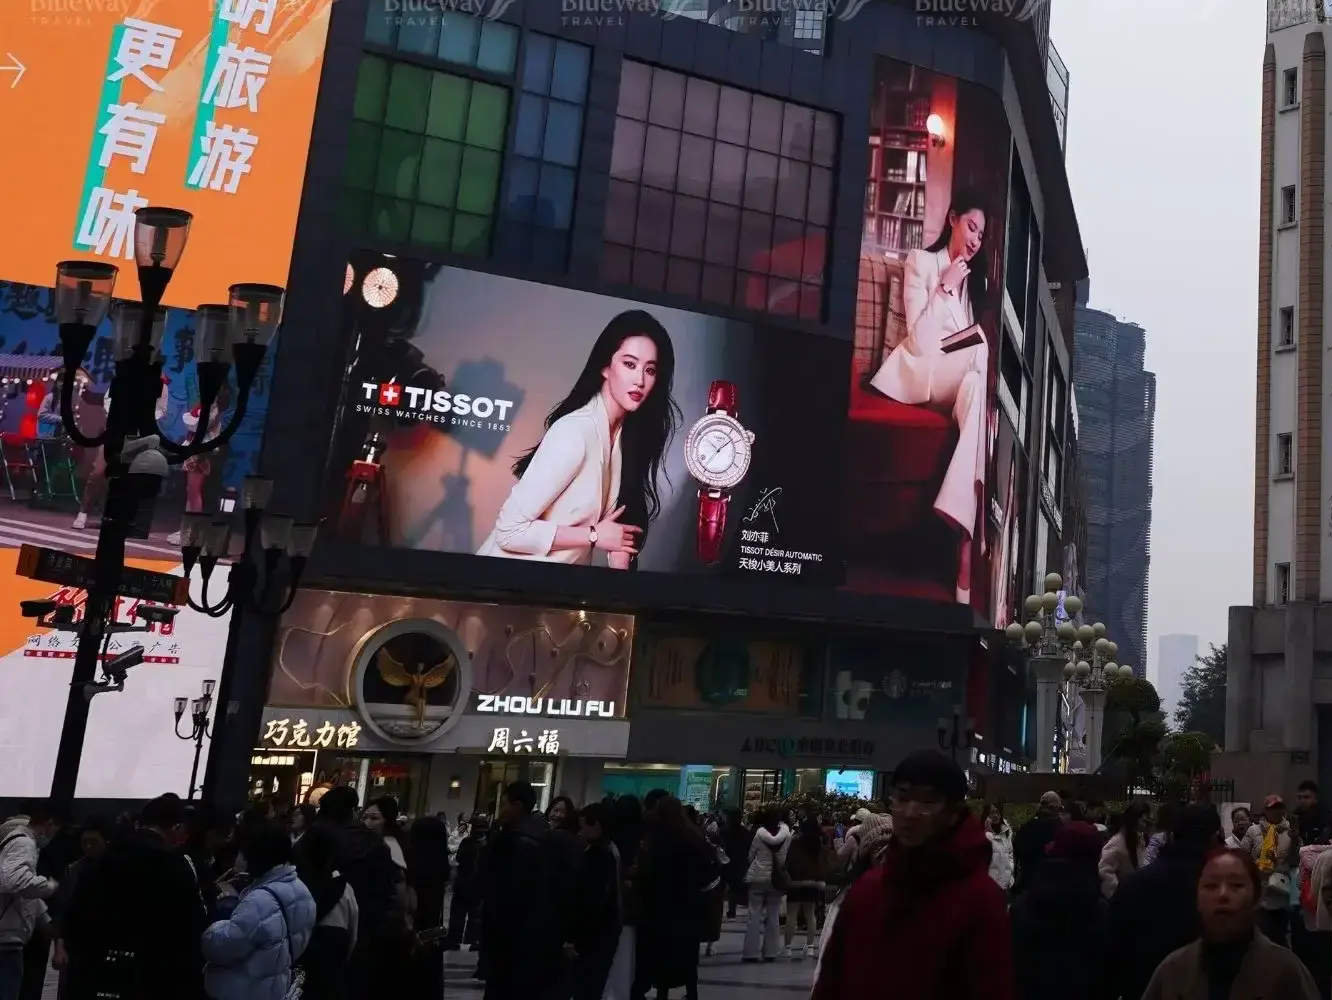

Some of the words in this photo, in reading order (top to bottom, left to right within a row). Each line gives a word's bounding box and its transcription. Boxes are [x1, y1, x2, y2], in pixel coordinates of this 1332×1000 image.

[78, 17, 182, 260] 更有味
[404, 386, 513, 421] TISSOT
[356, 404, 391, 417] SWISS
[395, 409, 446, 424] WATCHES
[450, 417, 483, 429] SINCE
[741, 529, 769, 543] 刘亦菲
[738, 557, 802, 575] 天梭小美人系列
[740, 545, 764, 555] TISSOT
[785, 551, 824, 562] AUTOMATIC
[476, 694, 544, 715] ZHOU
[546, 698, 582, 716] LIU
[584, 699, 615, 717] FU
[264, 718, 362, 749] 巧克力馆
[487, 726, 561, 755] 周六福
